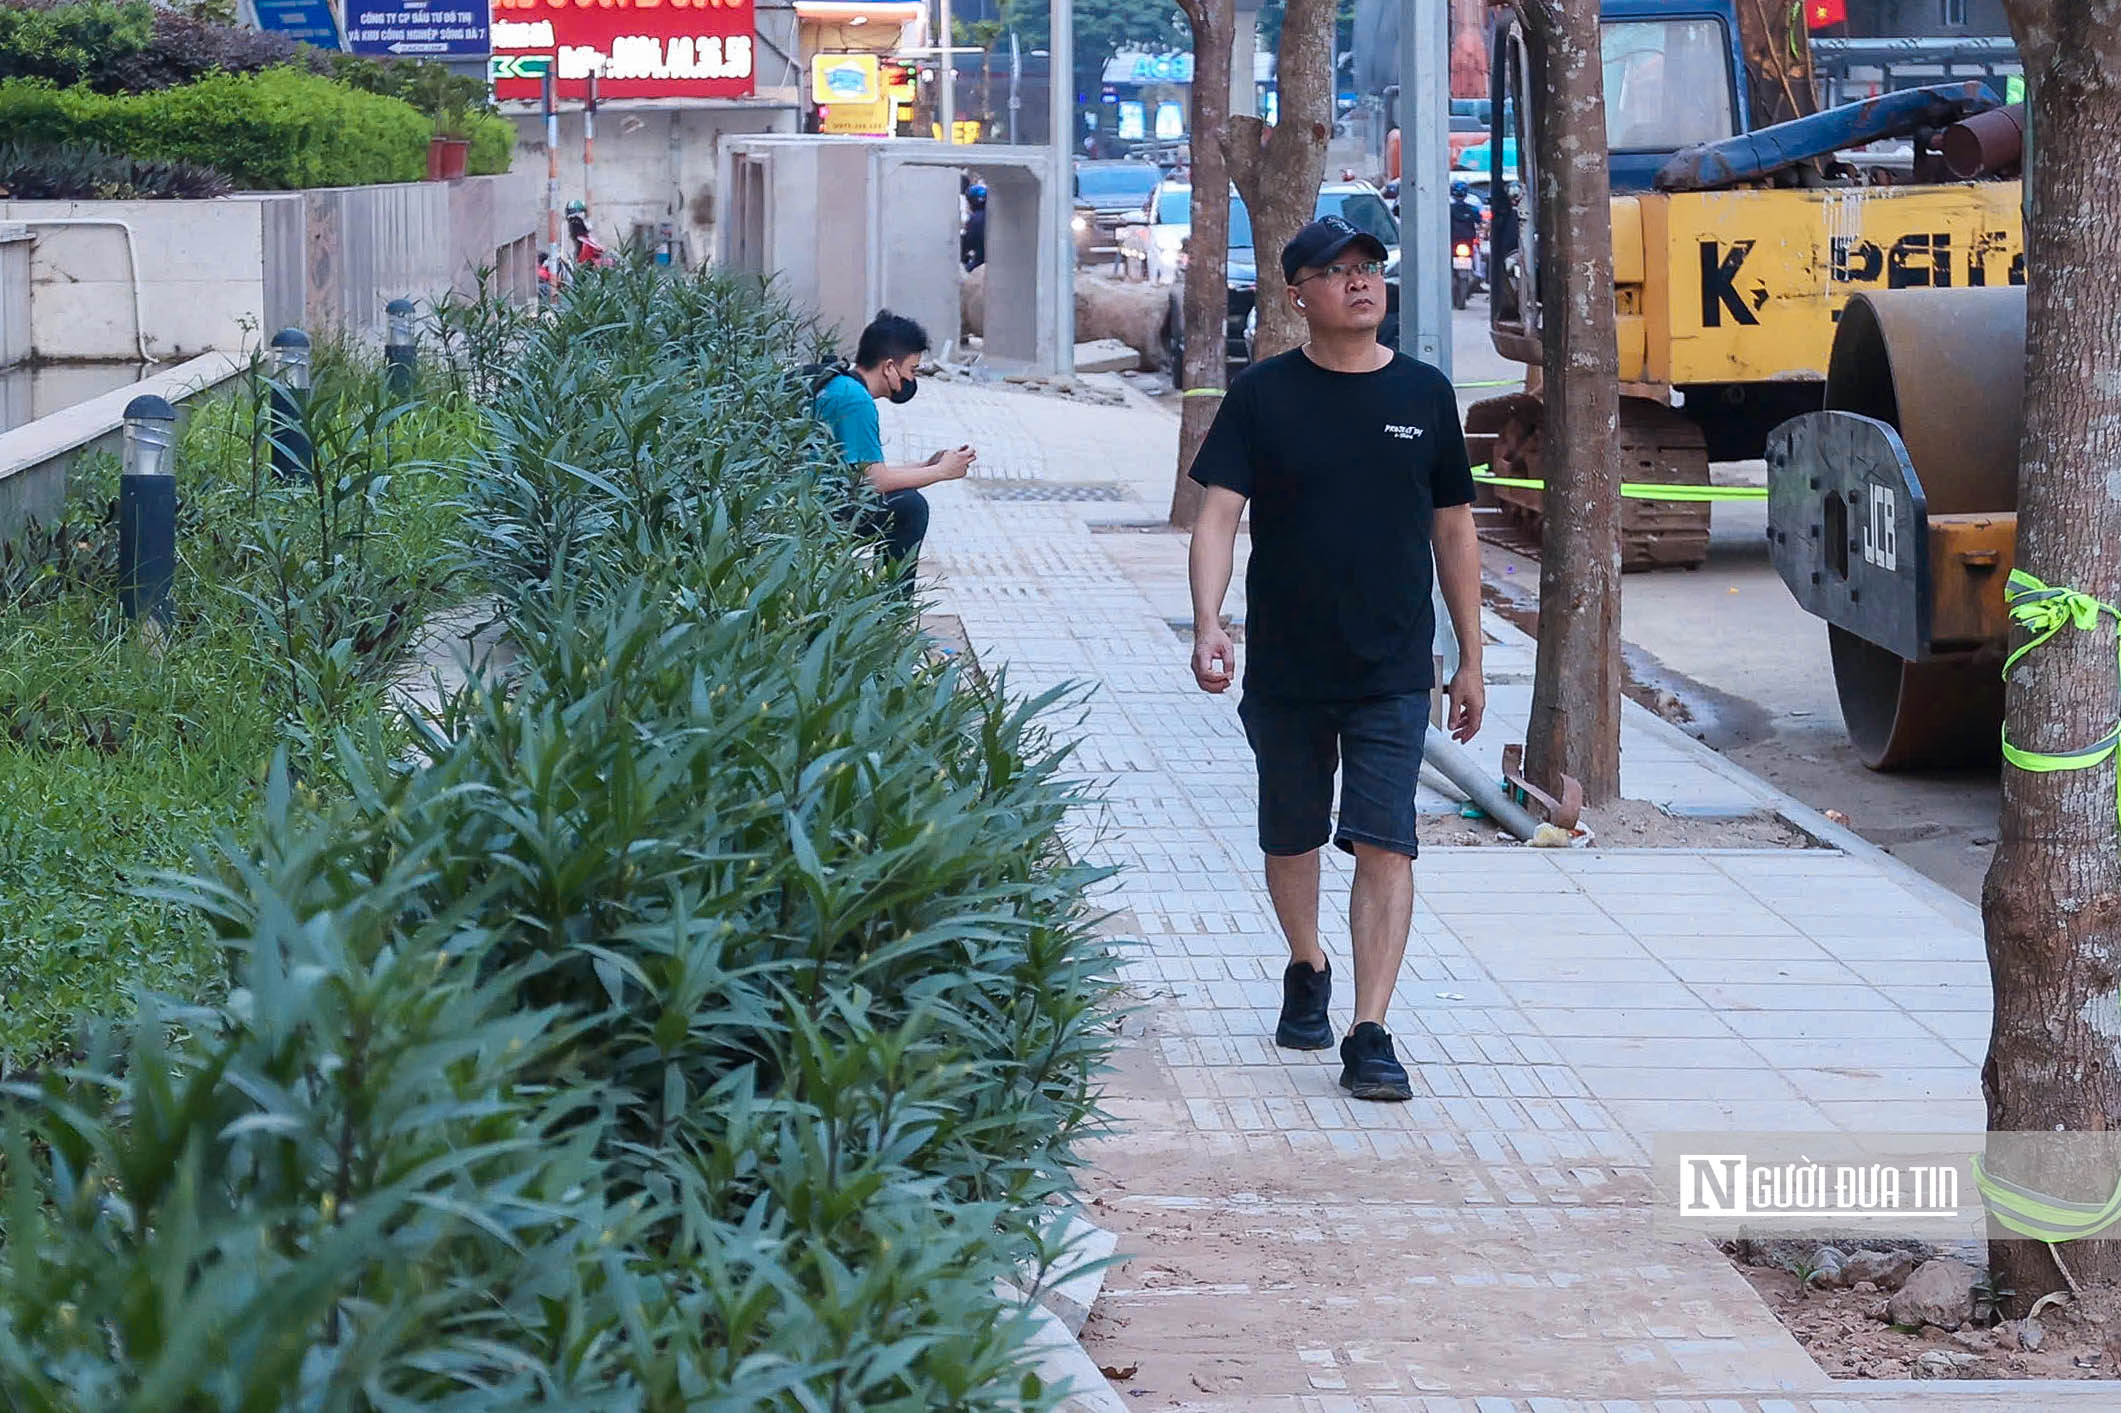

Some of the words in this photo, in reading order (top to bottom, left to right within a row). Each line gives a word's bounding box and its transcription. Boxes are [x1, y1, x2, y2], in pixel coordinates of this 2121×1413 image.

[360, 11, 385, 25] CÔNG
[386, 13, 397, 24] TY
[398, 13, 410, 24] CP
[348, 28, 360, 41] VÀ
[361, 30, 380, 41] KHU
[381, 27, 405, 41] CÔNG
[479, 28, 487, 40] 7
[1863, 482, 1896, 572] JCB
